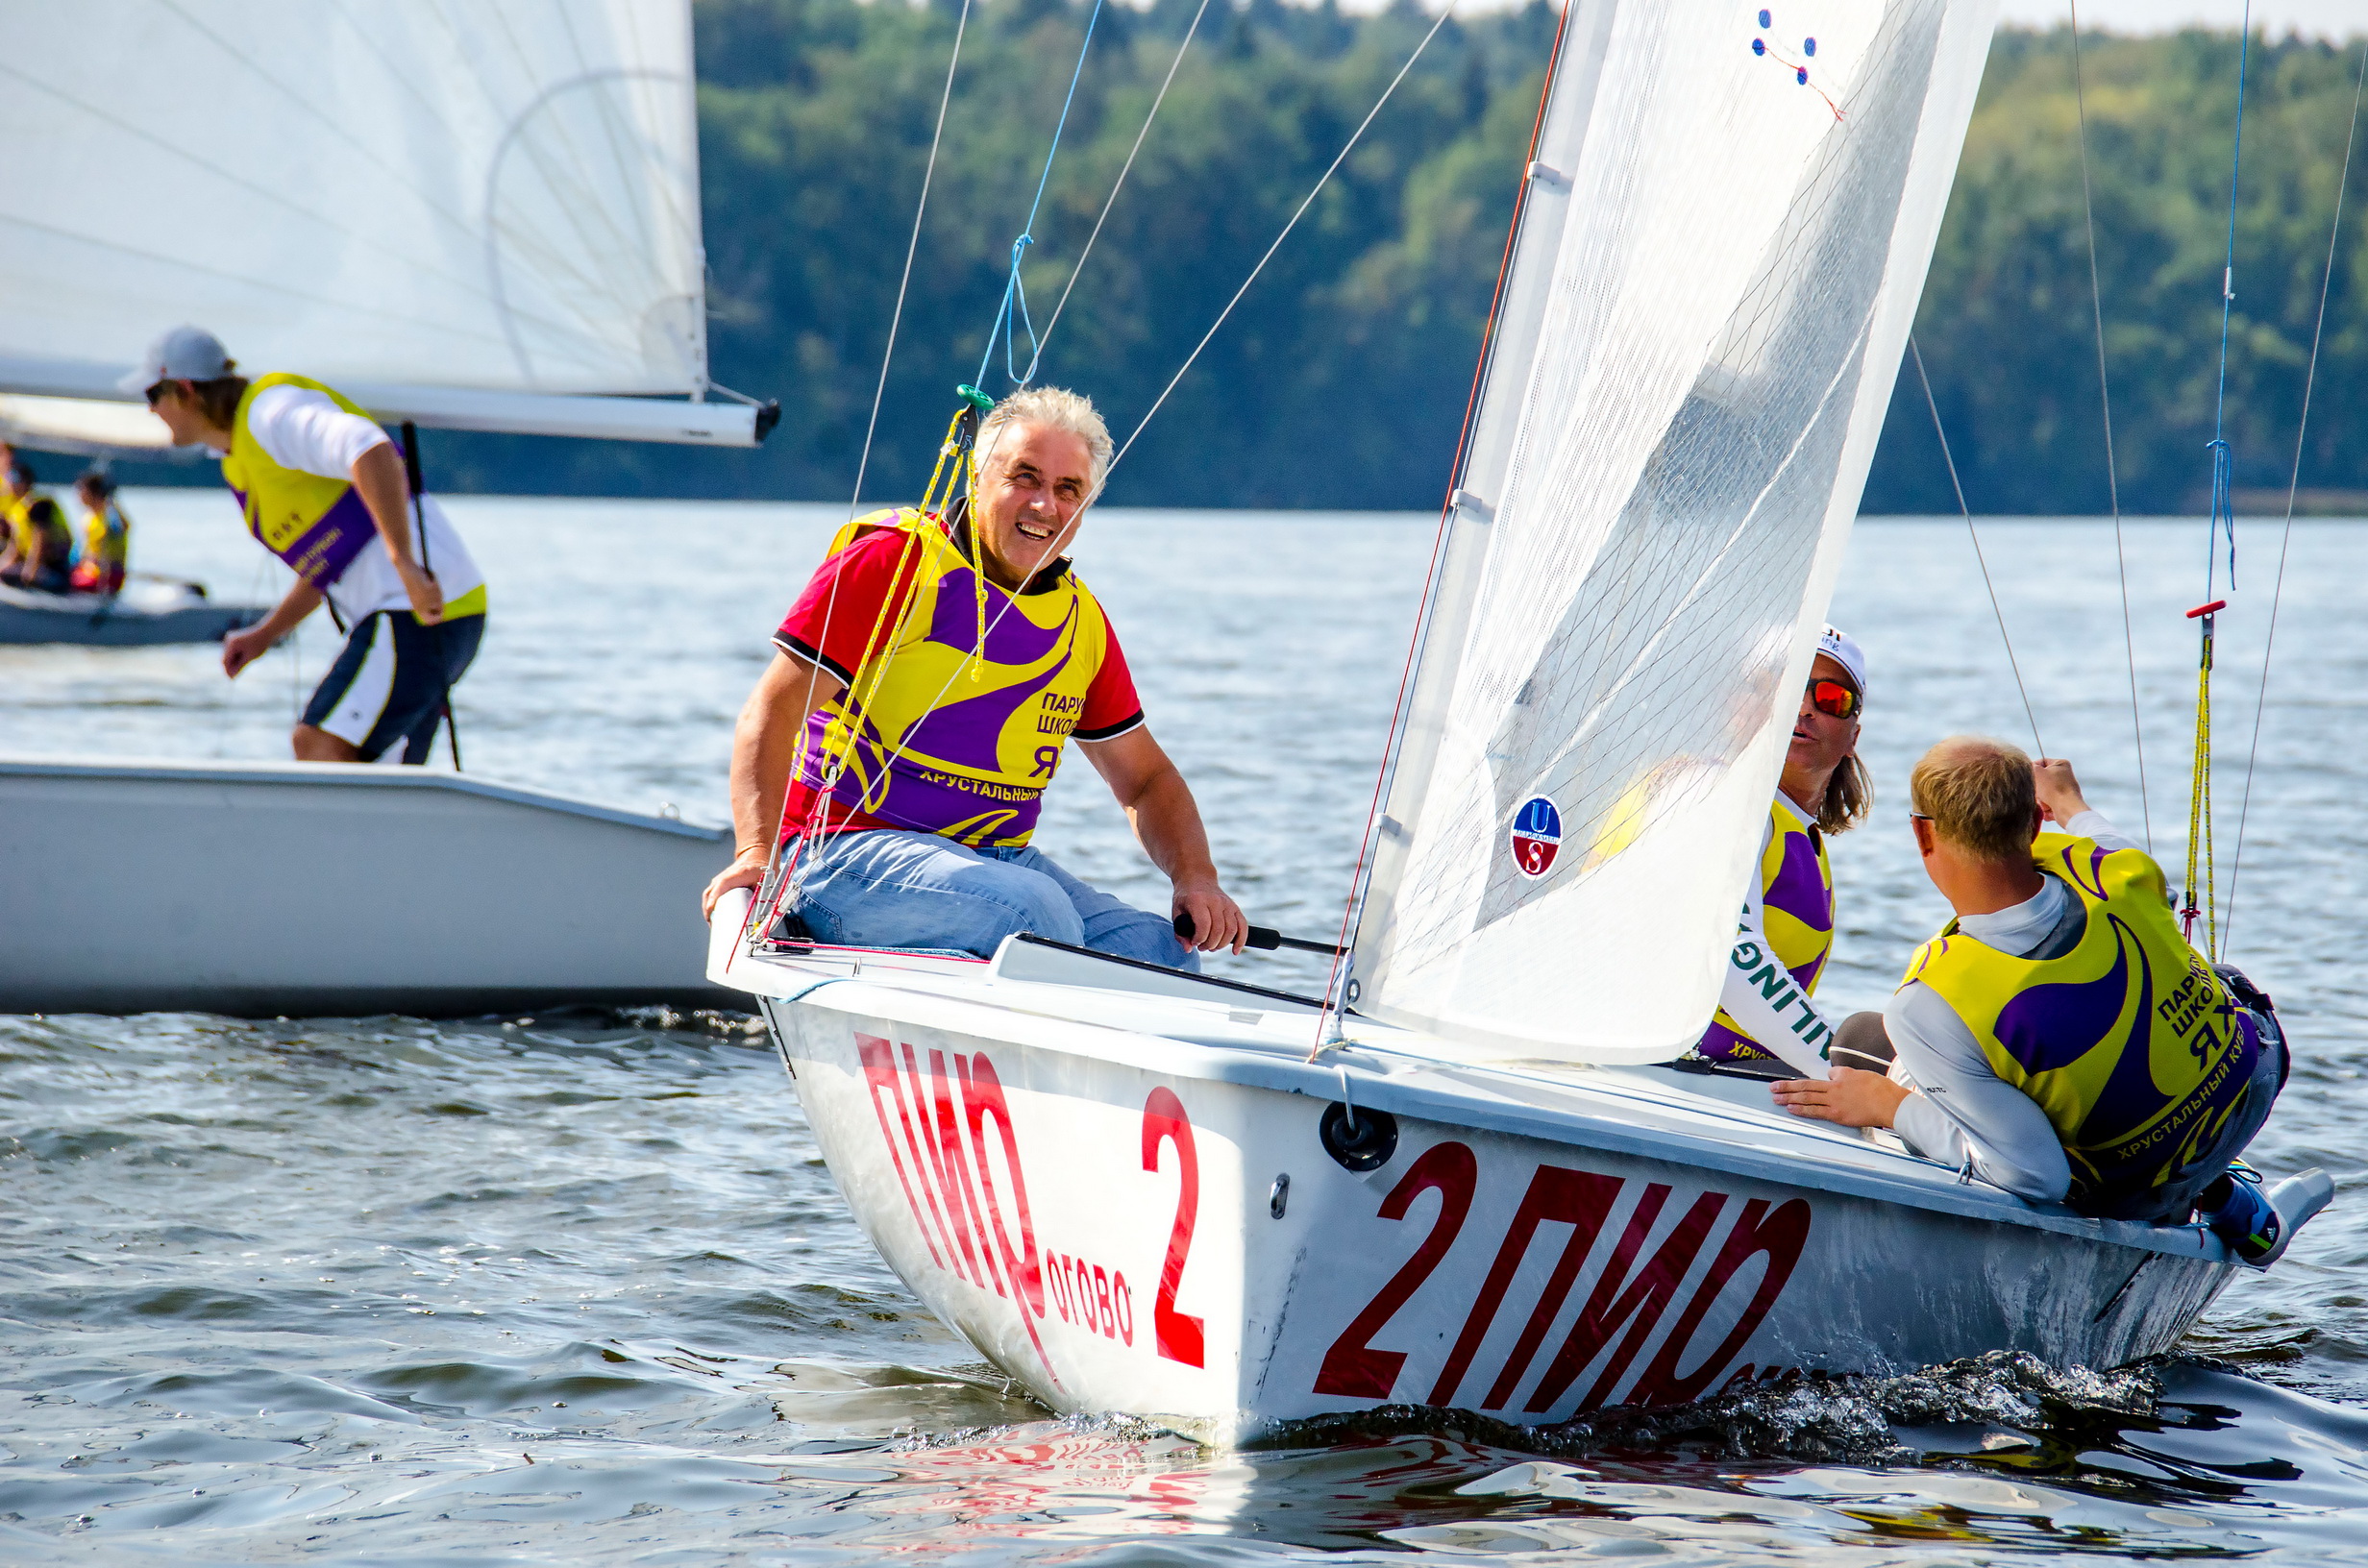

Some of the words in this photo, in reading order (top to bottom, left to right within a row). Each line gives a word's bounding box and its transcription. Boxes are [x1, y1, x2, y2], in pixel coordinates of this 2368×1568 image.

[2117, 1061, 2231, 1160] ХРУСТАЛЬНЫЙ
[2229, 1021, 2245, 1065] КУБ
[1141, 1086, 1205, 1370] 2
[1311, 1140, 1478, 1400] 2
